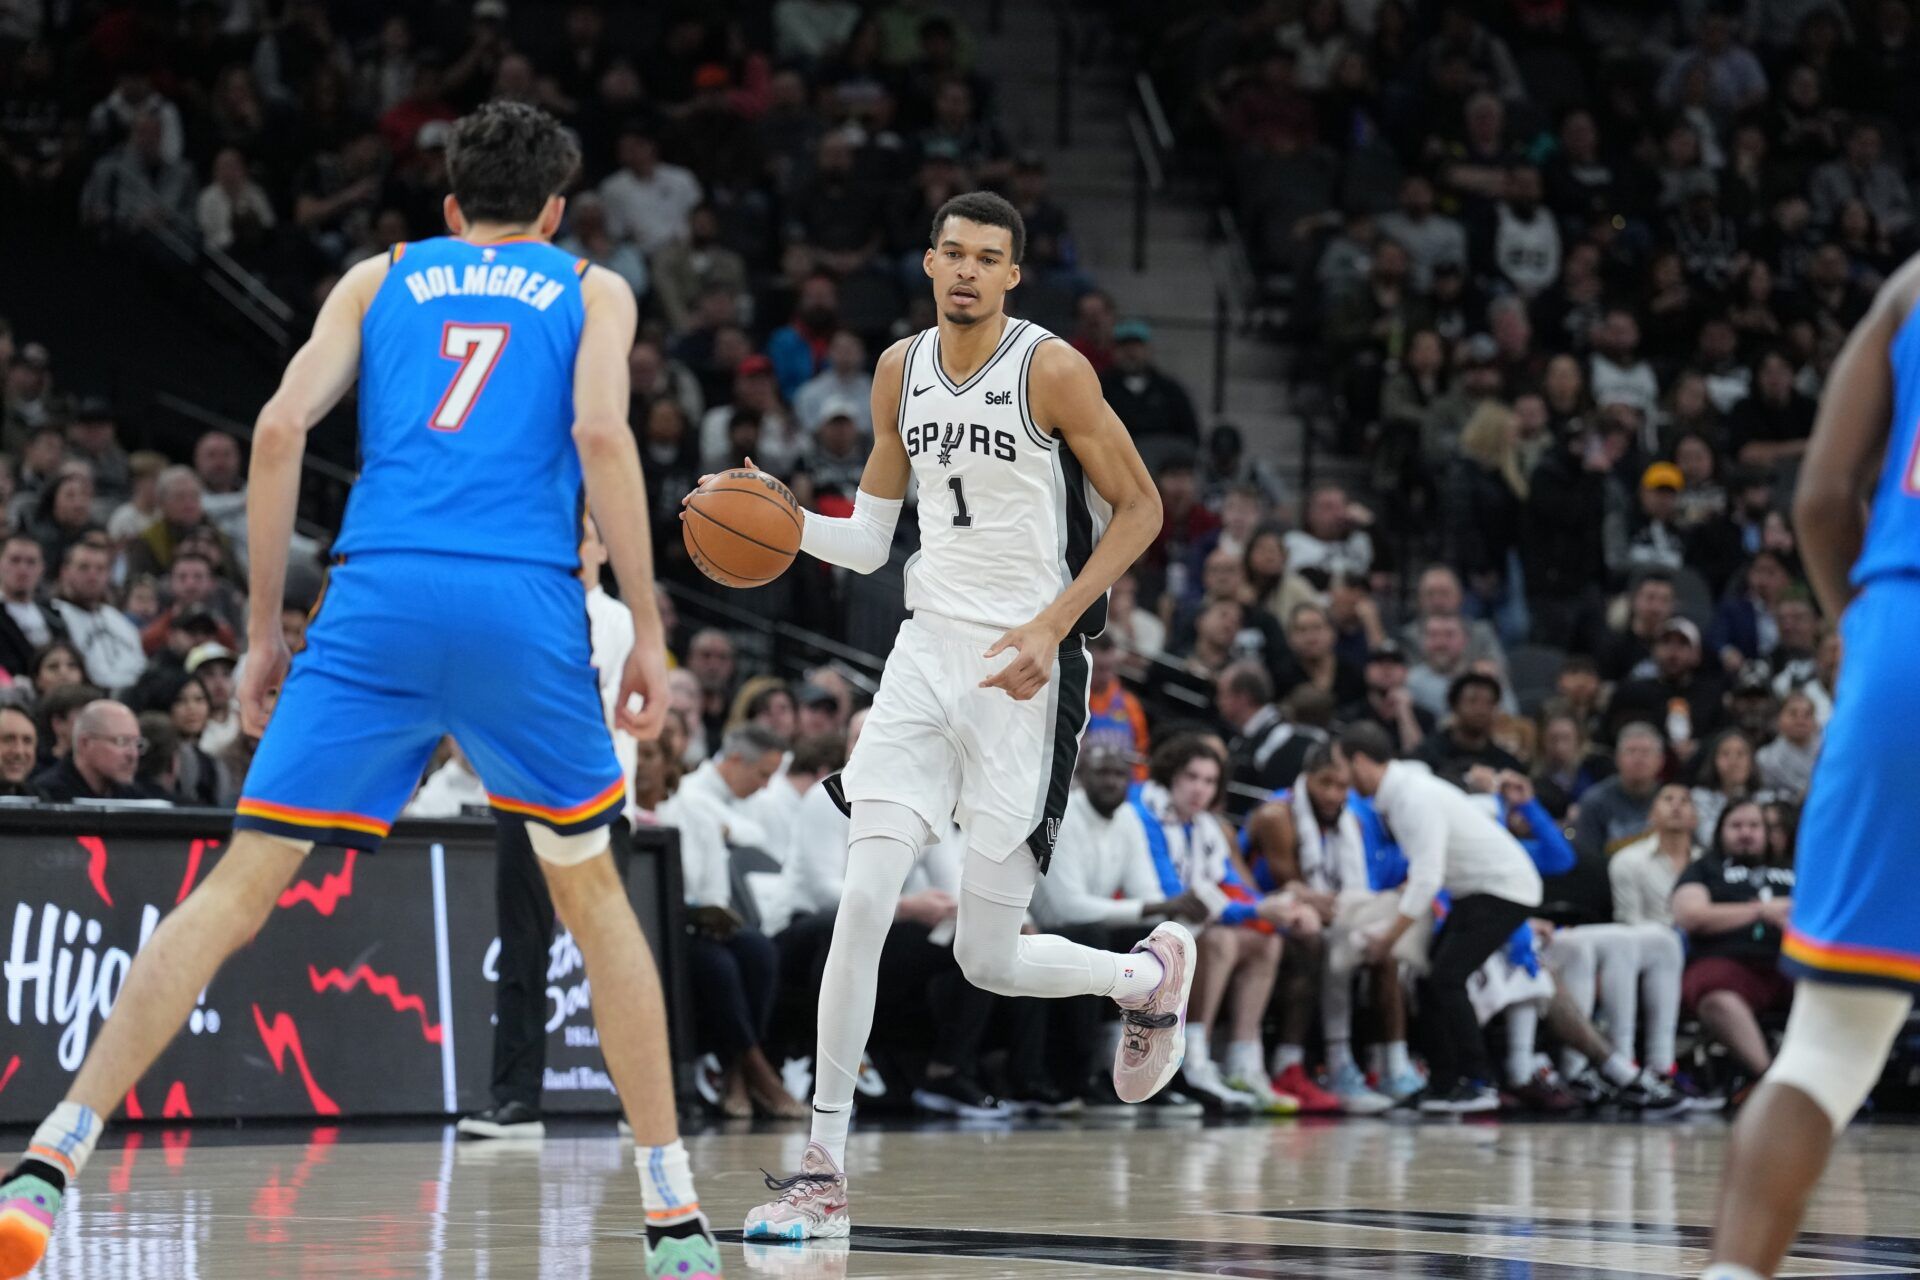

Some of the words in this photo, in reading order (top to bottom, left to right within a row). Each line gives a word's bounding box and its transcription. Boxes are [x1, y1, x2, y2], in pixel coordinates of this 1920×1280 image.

[404, 264, 565, 312] HOLMGREN
[427, 320, 512, 433] 7
[984, 390, 1013, 406] Self.
[906, 421, 1017, 469] SPURS
[947, 474, 975, 529] 1
